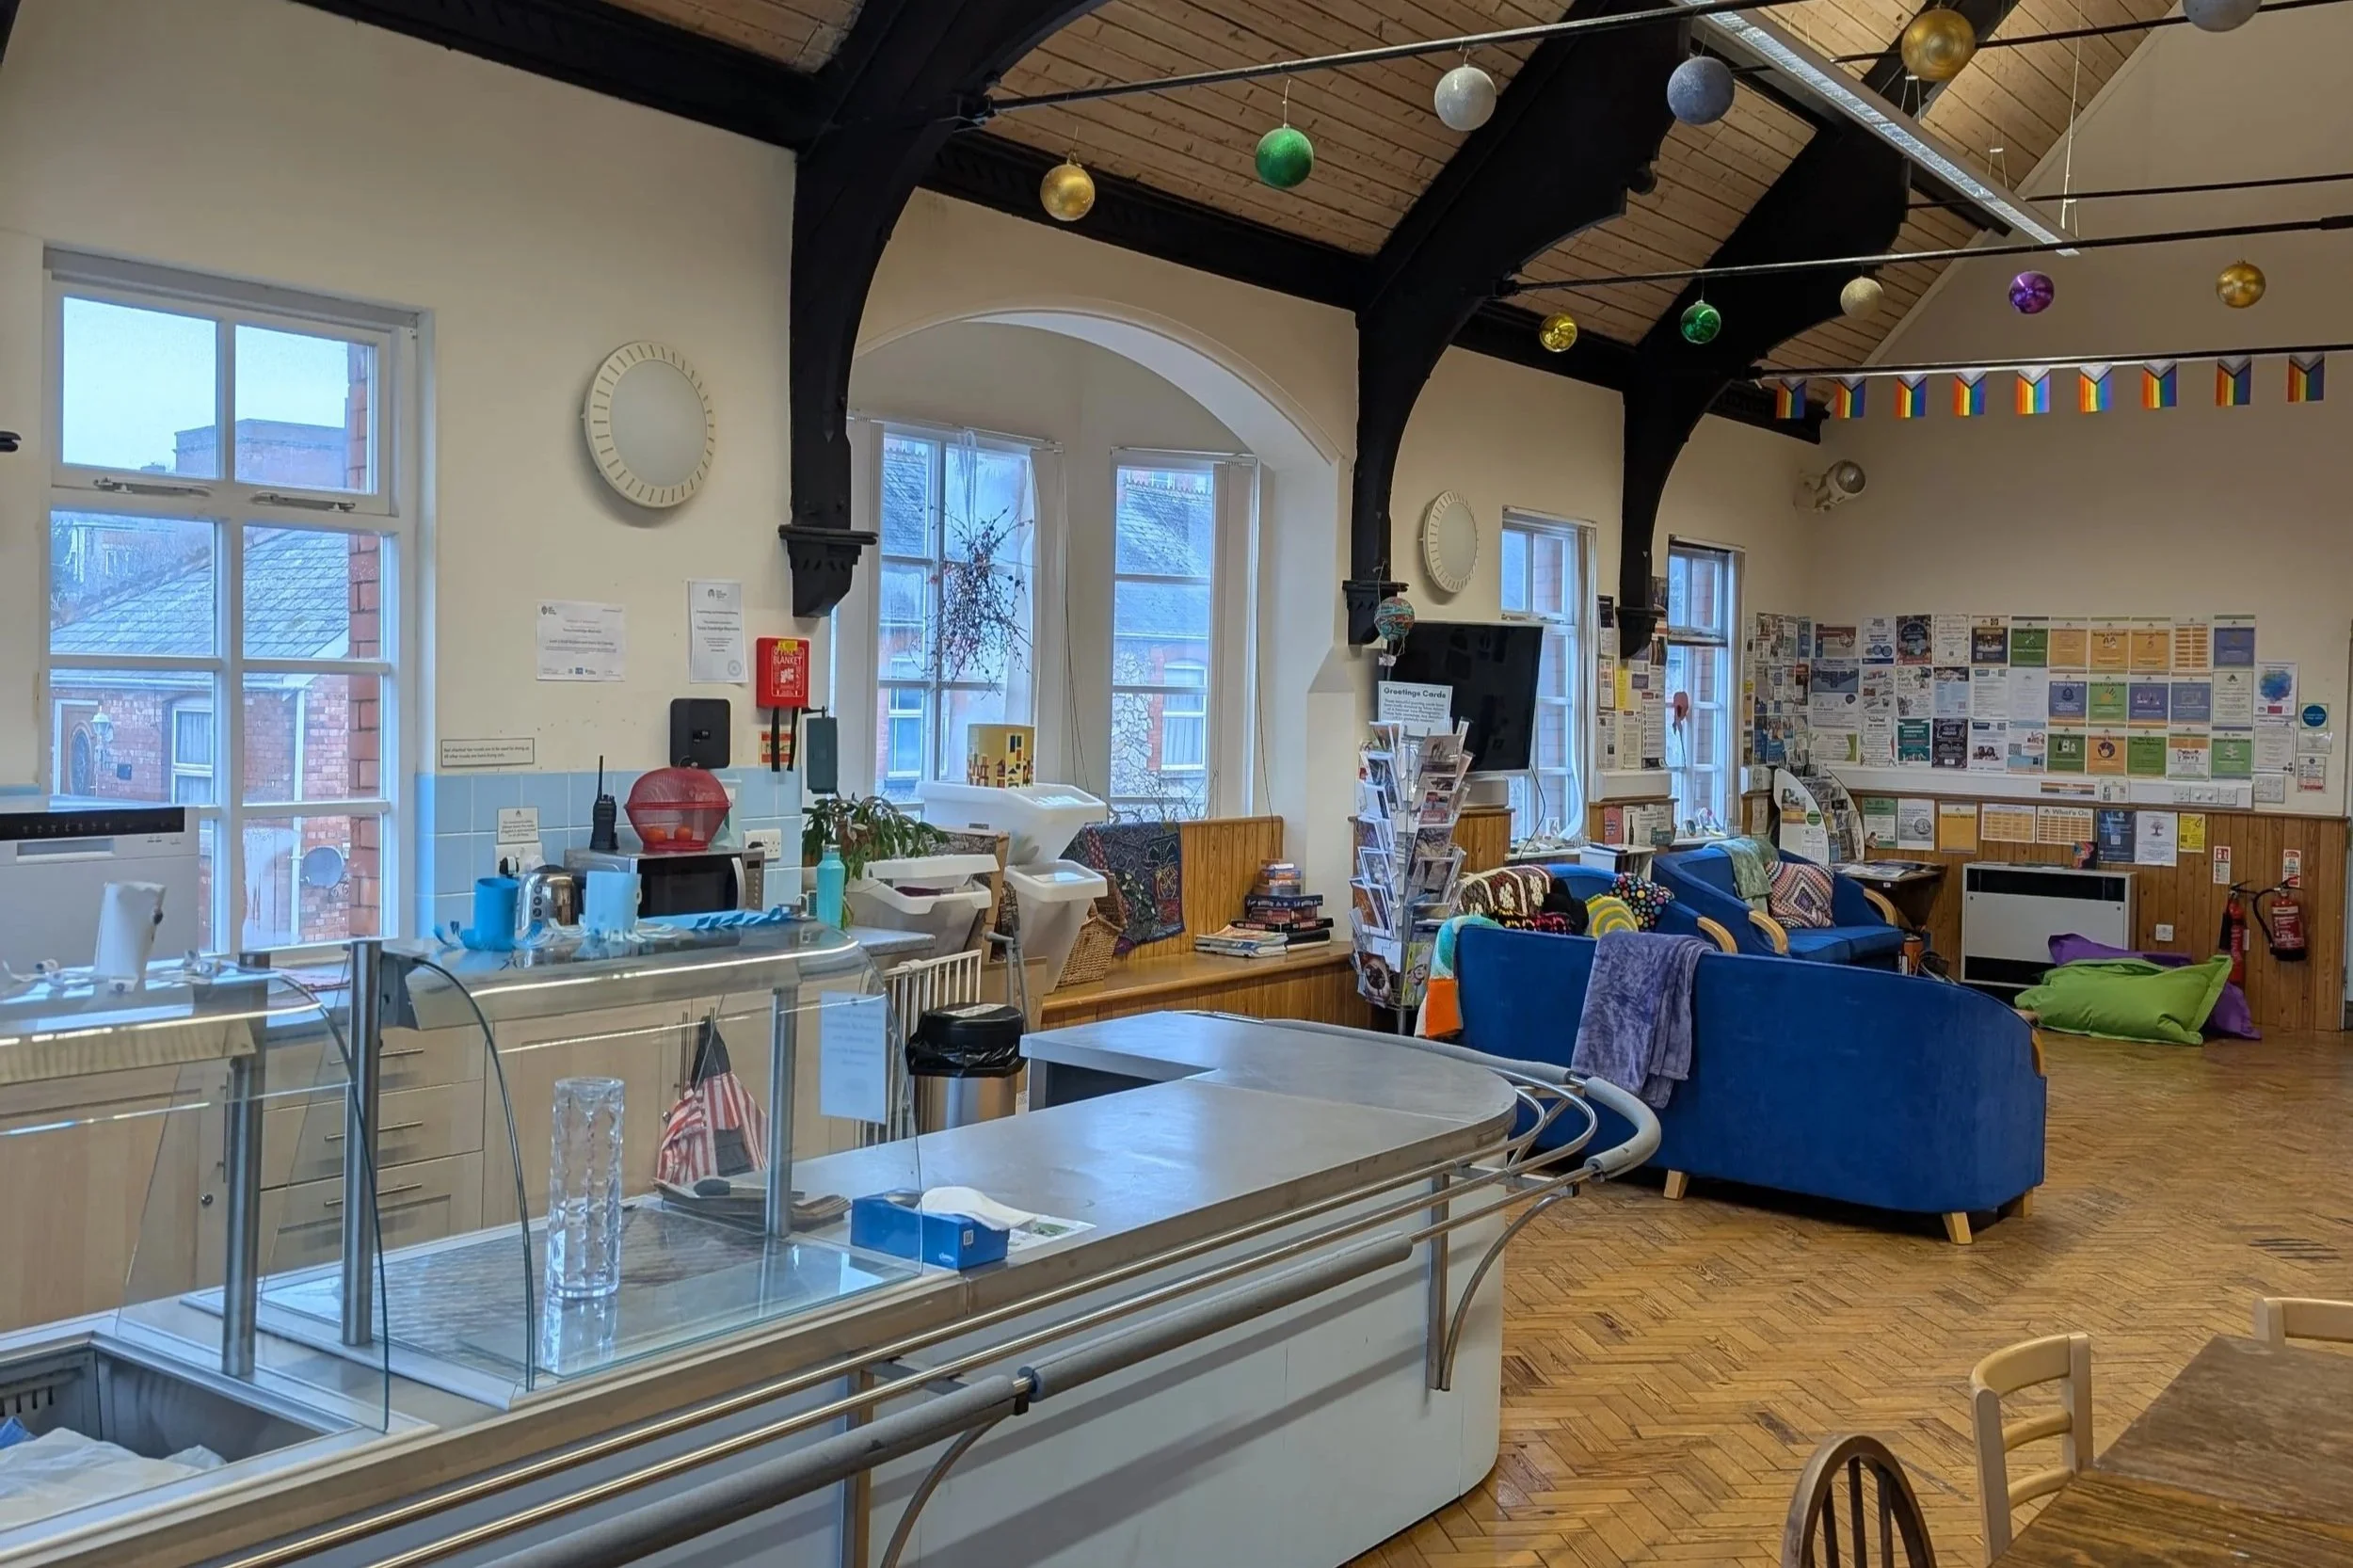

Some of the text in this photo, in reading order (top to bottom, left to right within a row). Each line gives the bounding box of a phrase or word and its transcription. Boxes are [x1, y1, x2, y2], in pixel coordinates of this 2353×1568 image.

[773, 656, 802, 664] BLANKET
[1384, 687, 1447, 698] Greetings Cards
